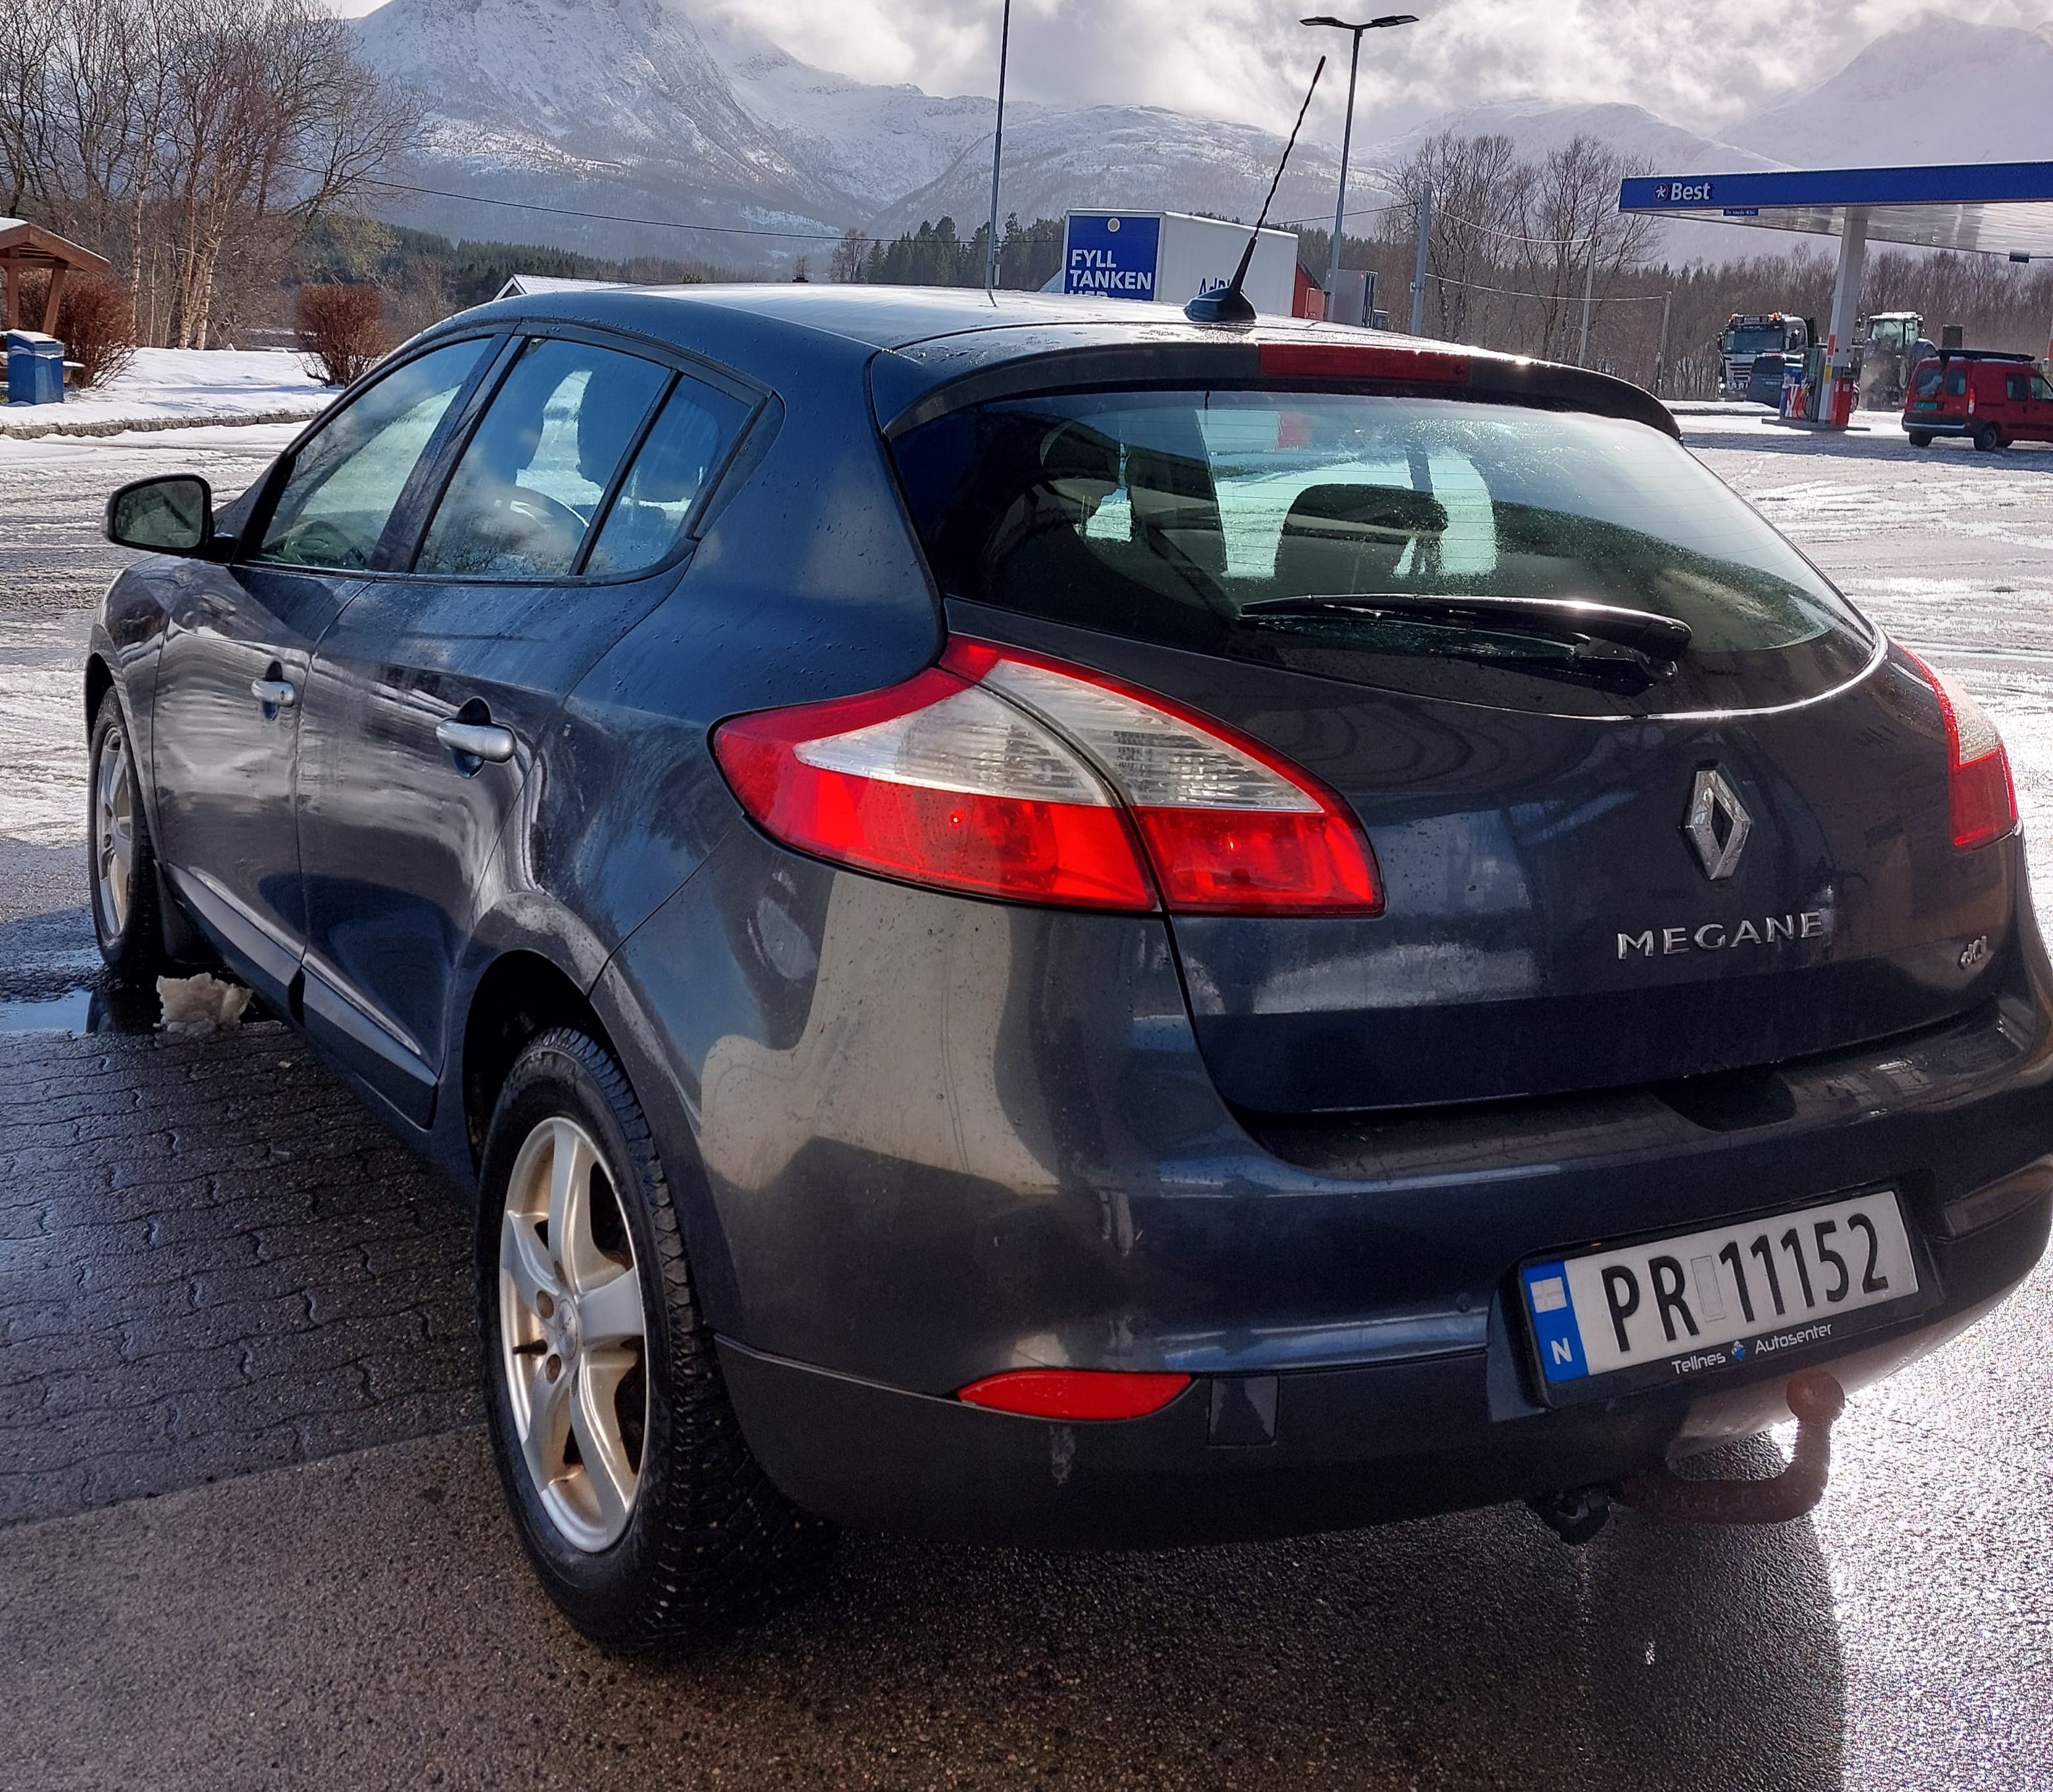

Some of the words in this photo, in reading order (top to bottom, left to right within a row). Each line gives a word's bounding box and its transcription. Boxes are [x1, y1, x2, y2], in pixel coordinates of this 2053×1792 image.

[1671, 182, 1711, 200] Best
[1071, 249, 1117, 268] FYLL
[1069, 269, 1152, 290] TANKEN
[1617, 911, 1824, 960] MEGANE
[1601, 1255, 1699, 1353] PR
[1718, 1213, 1889, 1323] 11152
[1550, 1337, 1573, 1365] N
[1671, 1352, 1726, 1375] Tellnes
[1754, 1323, 1832, 1355] Autosenter
